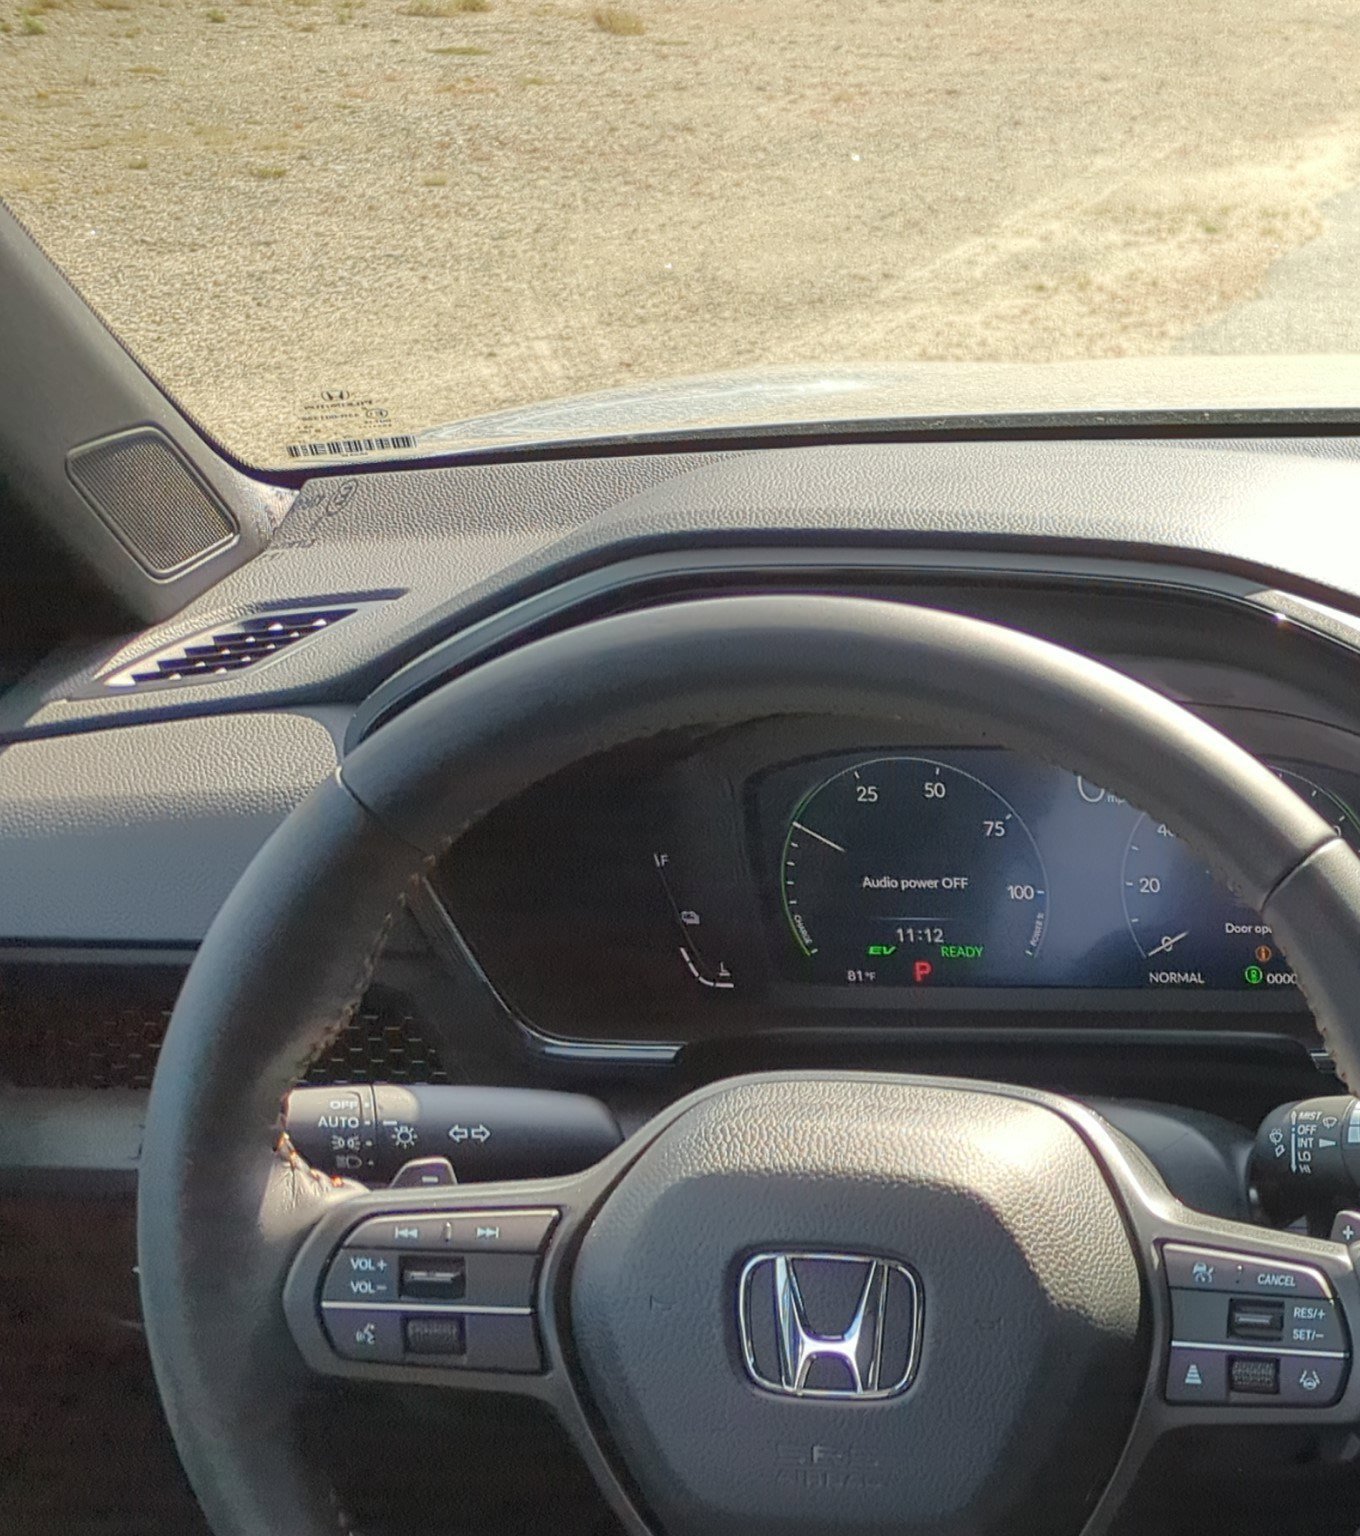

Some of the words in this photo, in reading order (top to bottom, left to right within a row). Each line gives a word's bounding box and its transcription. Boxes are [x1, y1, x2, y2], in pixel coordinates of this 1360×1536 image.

[856, 786, 878, 803] 25
[924, 782, 945, 799] 50
[983, 821, 1005, 837] 75
[863, 876, 899, 890] Audio
[902, 877, 939, 892] power
[942, 876, 968, 889] OFF
[1139, 878, 1160, 893] 20
[1007, 885, 1034, 900] 100
[1225, 922, 1252, 934] Door
[896, 928, 944, 943] 11:12
[868, 946, 896, 955] EV
[941, 945, 984, 958] READY
[914, 962, 932, 981] P
[1149, 971, 1205, 985] NORMAL
[330, 1100, 358, 1110] OFF
[318, 1115, 360, 1128] AUTO
[1298, 1110, 1323, 1121] MIST
[1297, 1124, 1317, 1135] OFF
[1297, 1137, 1313, 1148] INT
[1297, 1150, 1312, 1162] LO
[1298, 1164, 1312, 1174] HI
[1257, 1273, 1296, 1287] CANCEL
[1293, 1306, 1326, 1320] RES/+
